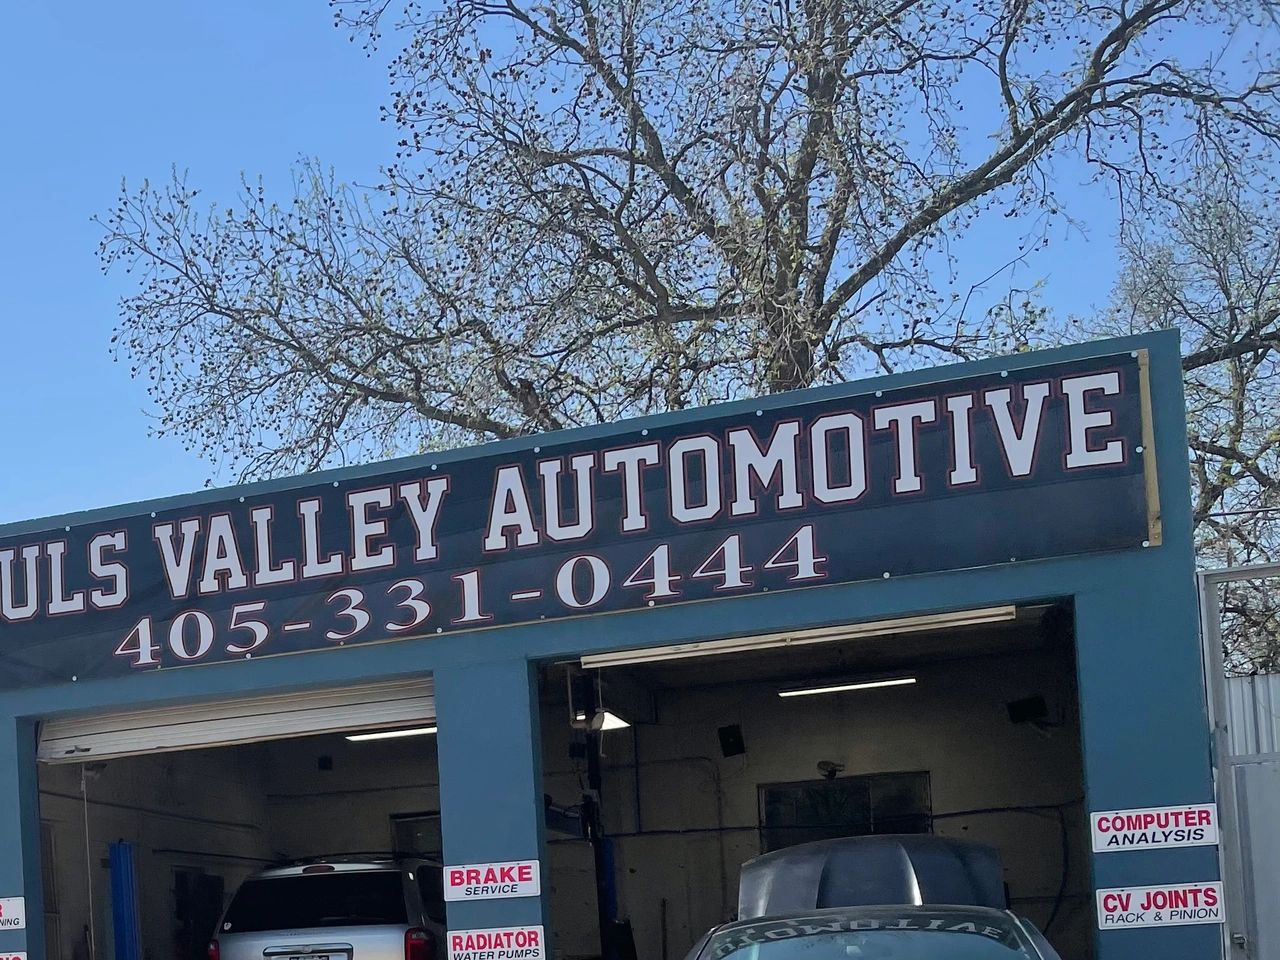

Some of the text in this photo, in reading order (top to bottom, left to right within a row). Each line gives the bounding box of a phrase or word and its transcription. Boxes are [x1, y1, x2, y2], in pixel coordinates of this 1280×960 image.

[152, 474, 450, 600] VALLEY
[482, 370, 1126, 553] AUTOMOTIVE
[113, 522, 828, 668] 405-331-0444
[1097, 809, 1211, 833] COMPUTER
[1107, 828, 1205, 847] ANALYSIS
[450, 865, 533, 887] BRAKE
[464, 883, 519, 896] SERVICE
[1103, 887, 1218, 913] CV JOINTS
[1104, 907, 1219, 924] RACK & PINION
[452, 930, 540, 951] RADIATOR
[453, 948, 540, 960] WATER PUMPS
